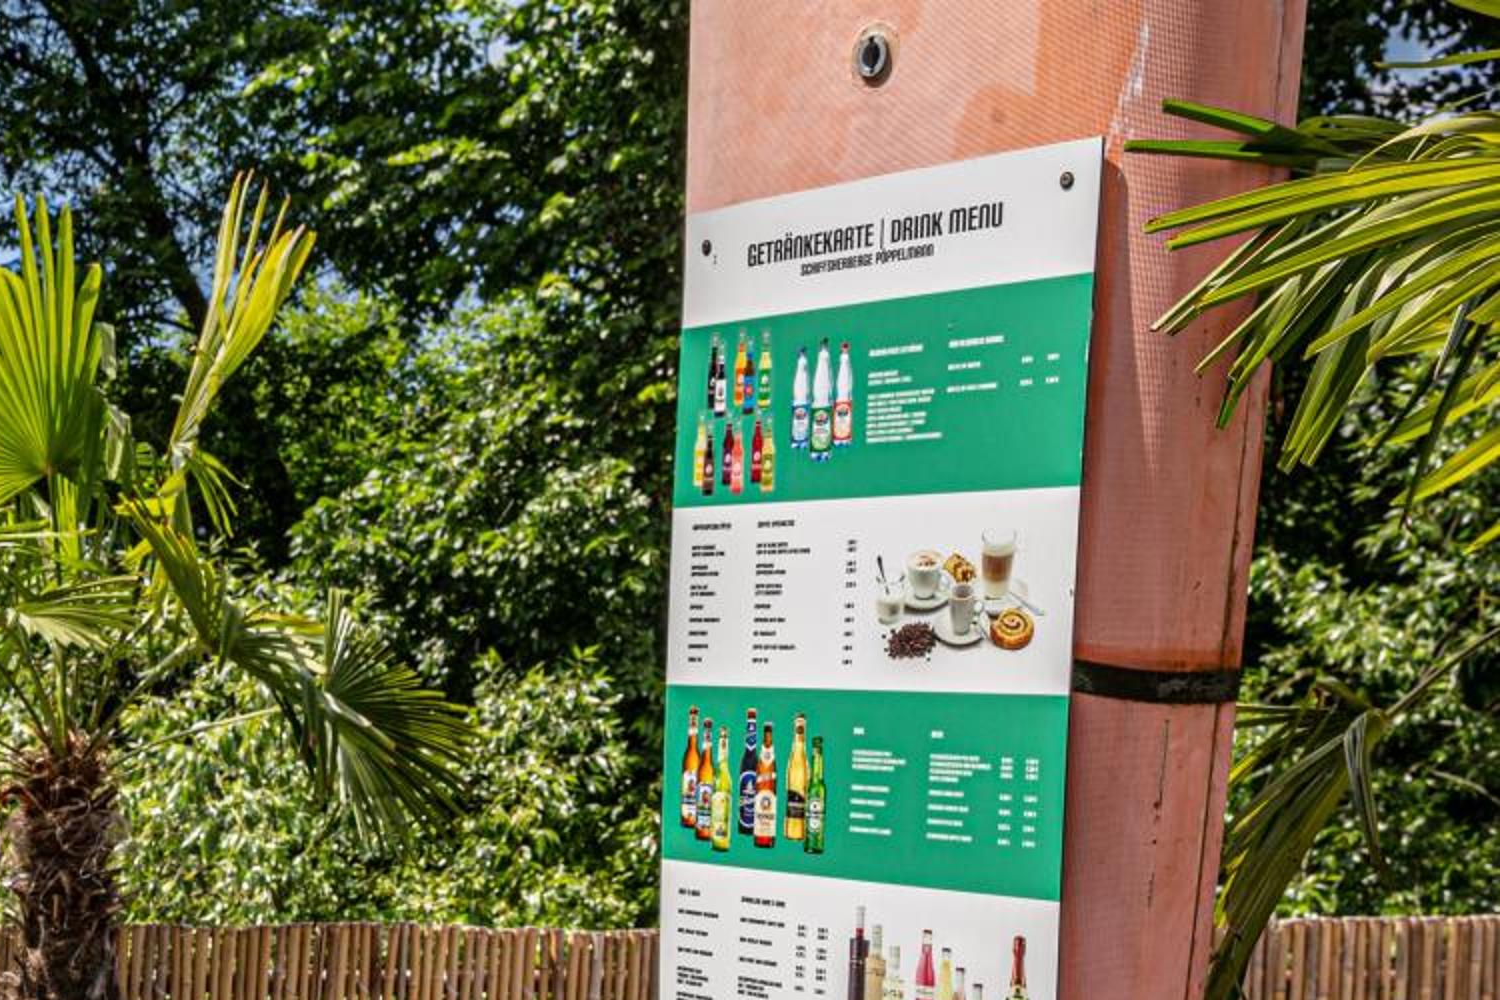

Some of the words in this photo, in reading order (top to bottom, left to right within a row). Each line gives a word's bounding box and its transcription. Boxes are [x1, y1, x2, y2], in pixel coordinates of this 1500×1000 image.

[747, 223, 874, 267] GETRÄNKEKARTE
[891, 211, 943, 243] DRINK
[948, 201, 1004, 234] MENU
[875, 244, 935, 265] PÖPPELMANN
